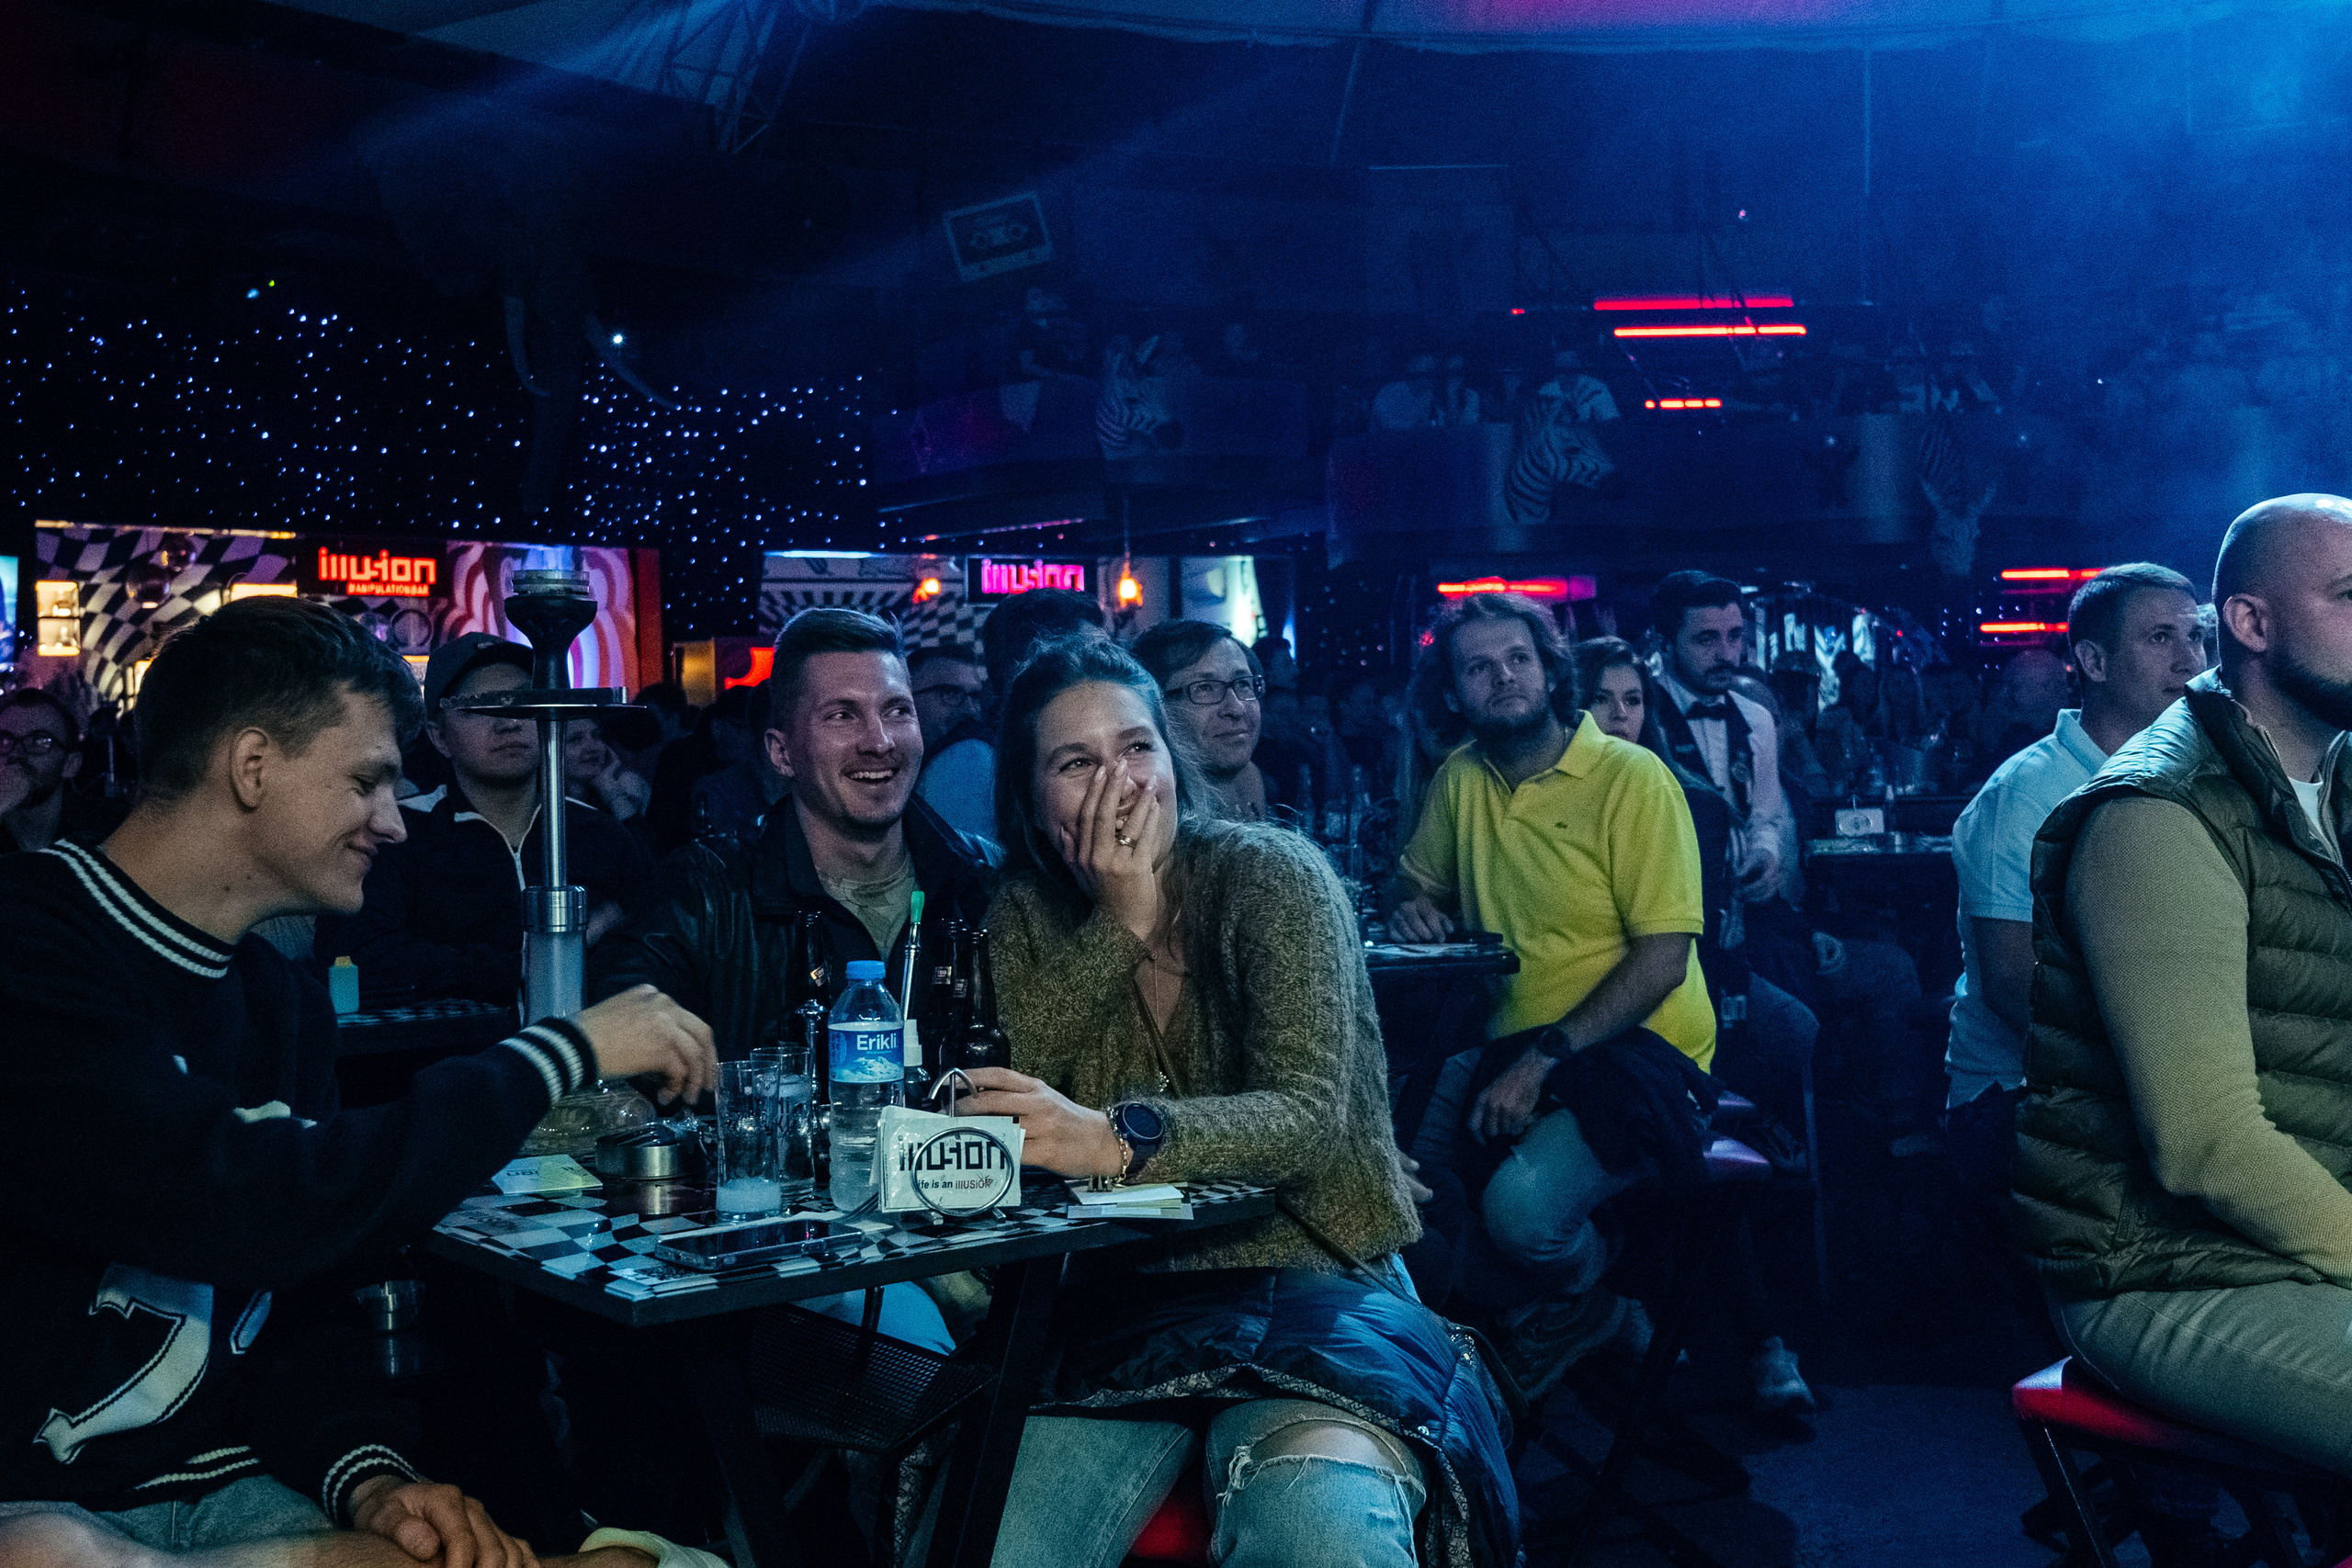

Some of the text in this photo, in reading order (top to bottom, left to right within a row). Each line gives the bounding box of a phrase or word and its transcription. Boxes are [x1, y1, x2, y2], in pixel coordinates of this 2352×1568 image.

[347, 581, 410, 596] MANIPULATION
[856, 1032, 897, 1051] Erikli
[932, 1179, 939, 1189] is
